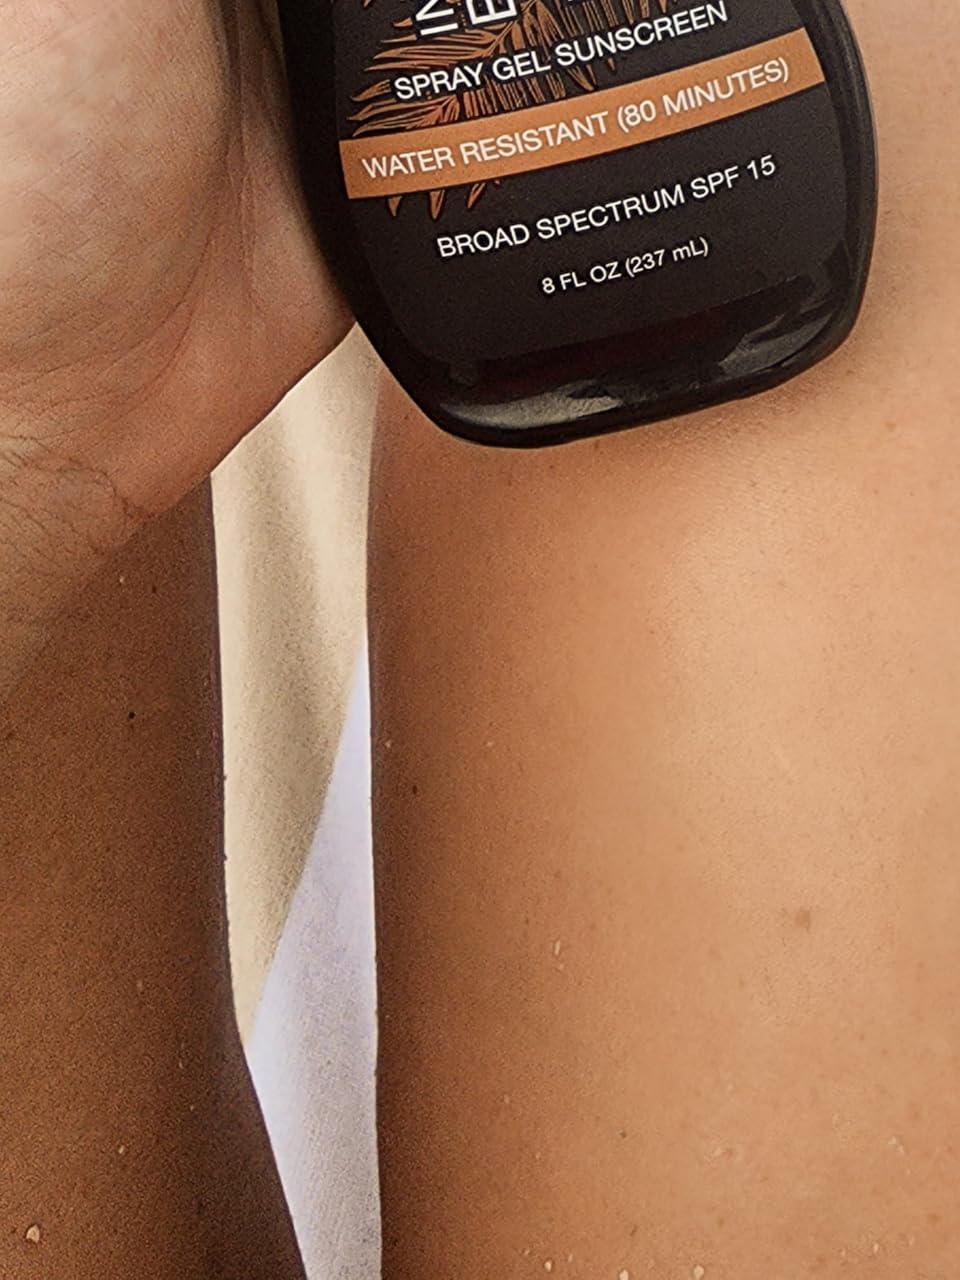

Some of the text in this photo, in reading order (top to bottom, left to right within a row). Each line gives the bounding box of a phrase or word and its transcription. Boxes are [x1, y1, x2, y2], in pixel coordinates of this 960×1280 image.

[394, 0, 728, 101] SPRAY GEL SUNSCREEN
[362, 57, 790, 179] WATER RESISTANT (80 MINUTES)
[436, 155, 776, 258] BROAD SPECTRUM SPF 15
[541, 237, 709, 294] 8 FL OZ (237 mL)
